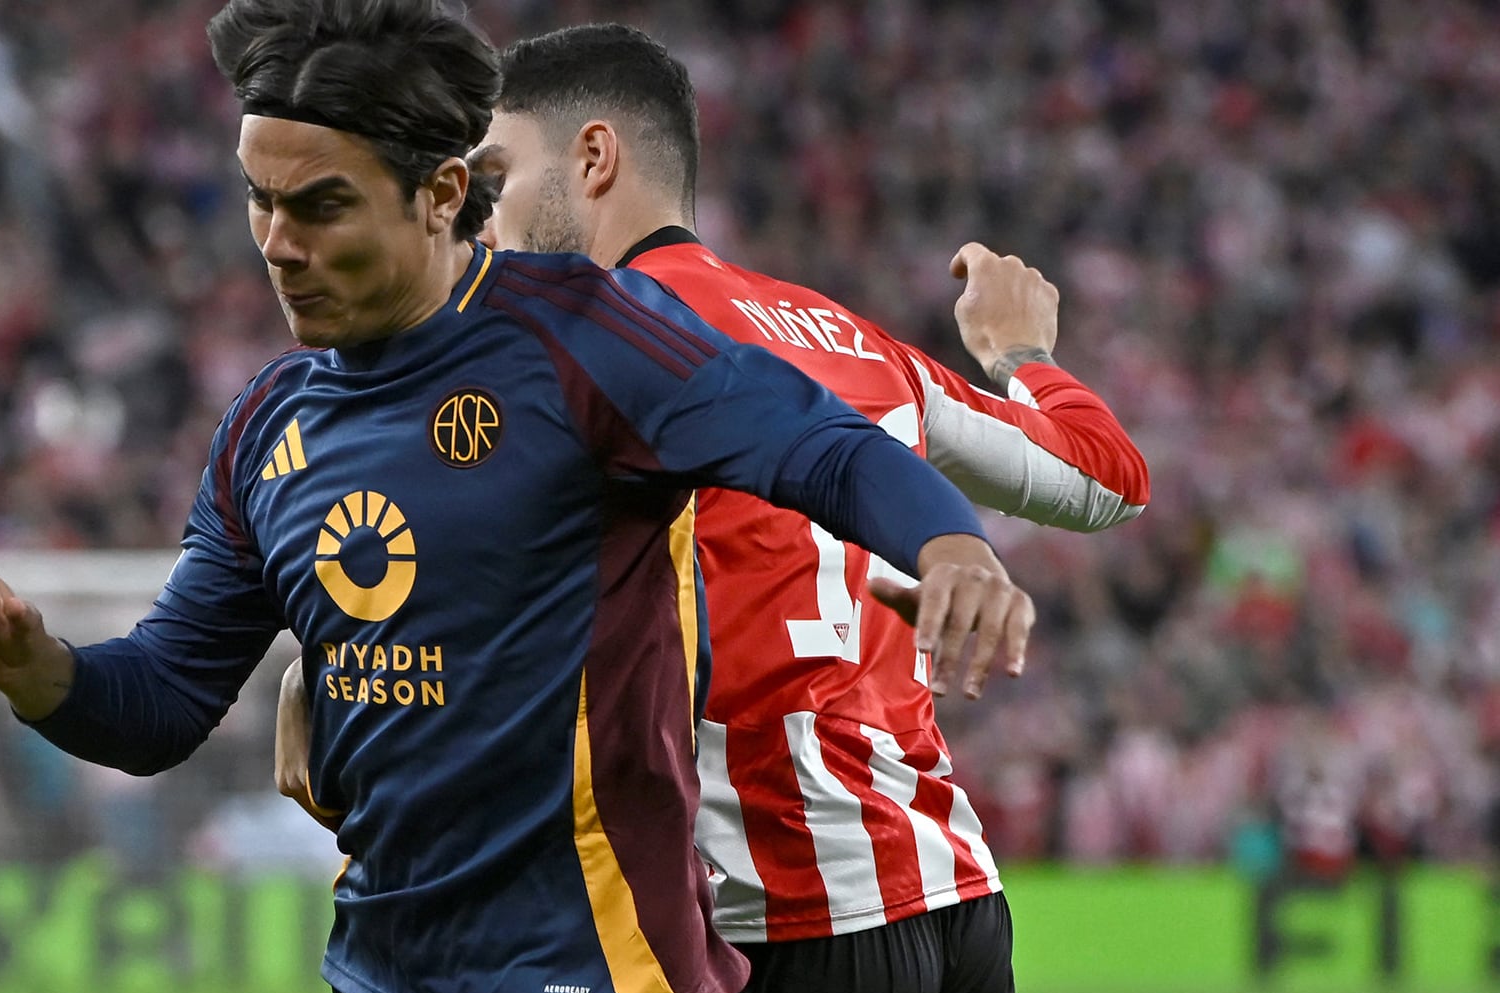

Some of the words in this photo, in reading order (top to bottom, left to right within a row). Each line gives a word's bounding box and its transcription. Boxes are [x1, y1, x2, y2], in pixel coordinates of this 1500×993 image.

[434, 394, 499, 462] ASR
[322, 642, 443, 672] RIYADH
[325, 674, 445, 706] SEASON
